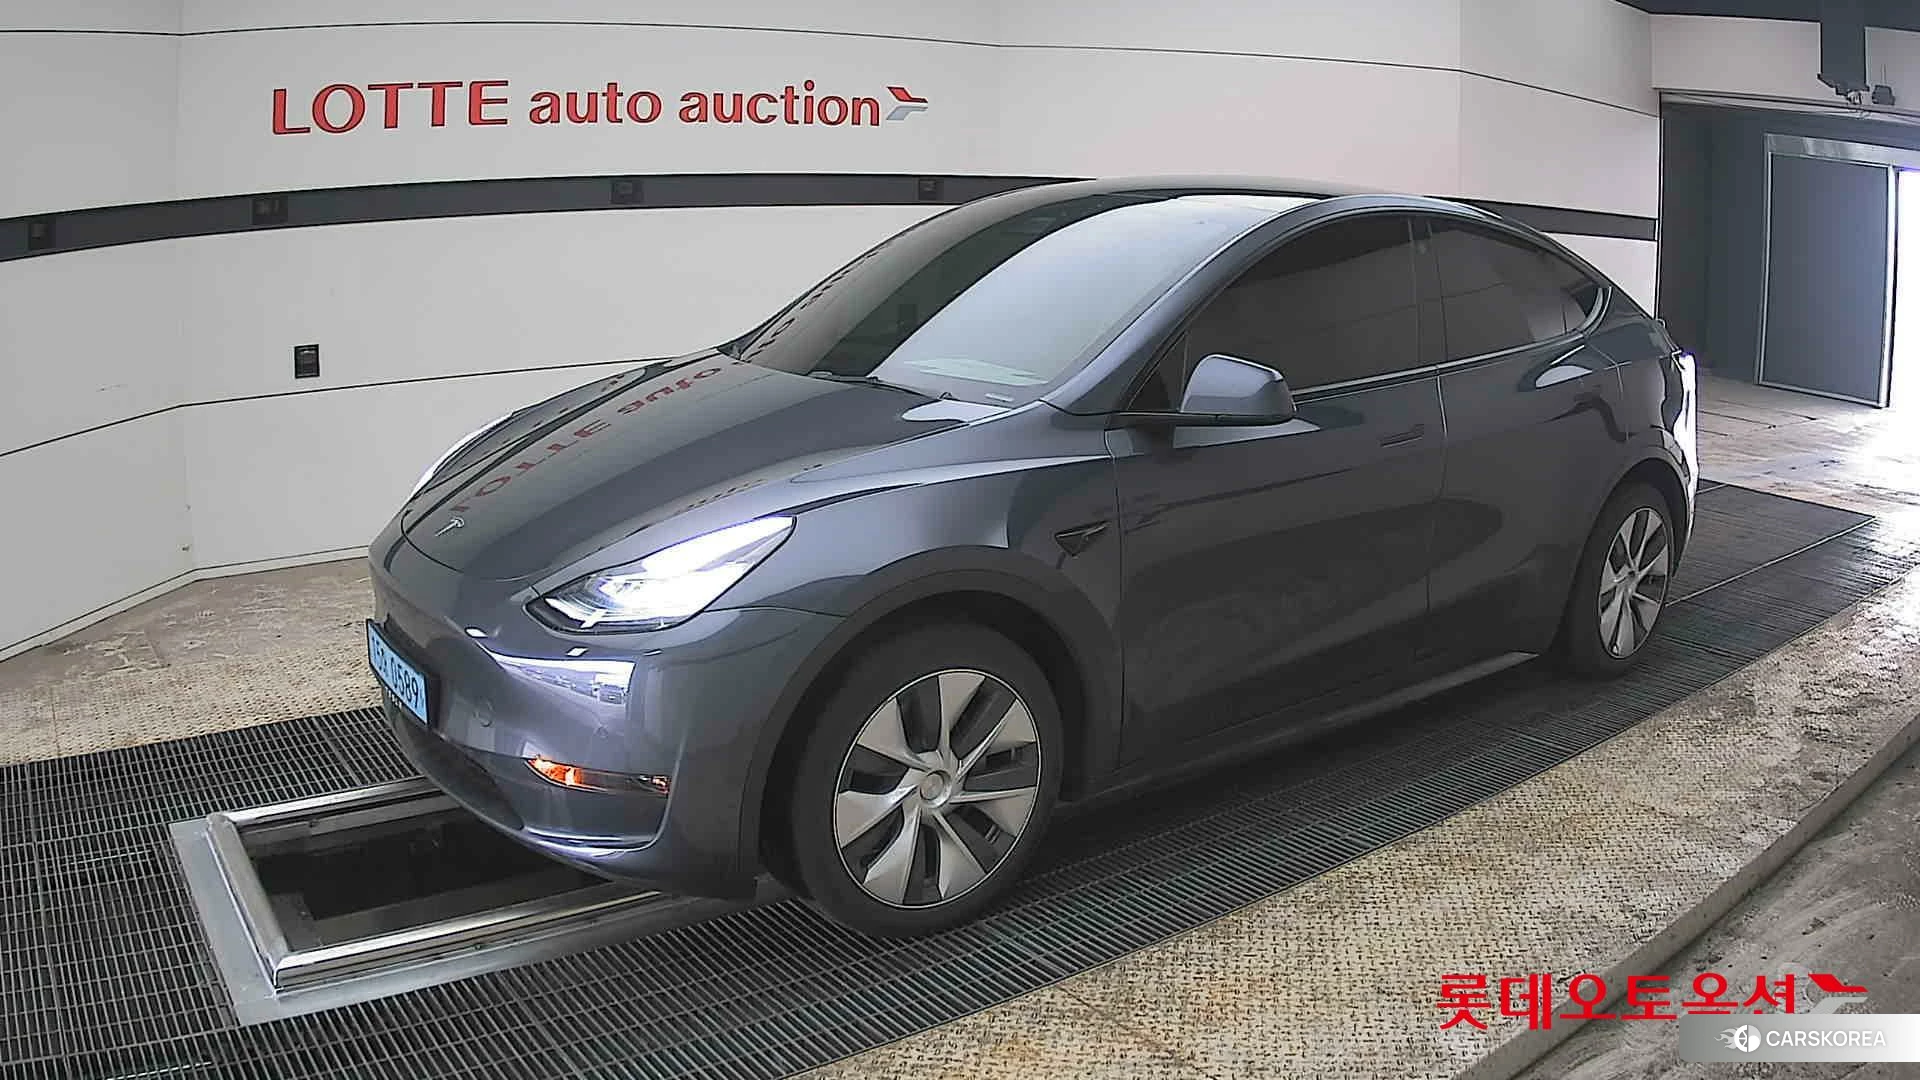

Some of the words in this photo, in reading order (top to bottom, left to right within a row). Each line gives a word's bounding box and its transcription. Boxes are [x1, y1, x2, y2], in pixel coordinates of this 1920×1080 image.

[272, 80, 509, 135] LOTTE
[529, 82, 662, 125] auto
[679, 79, 880, 127] auction
